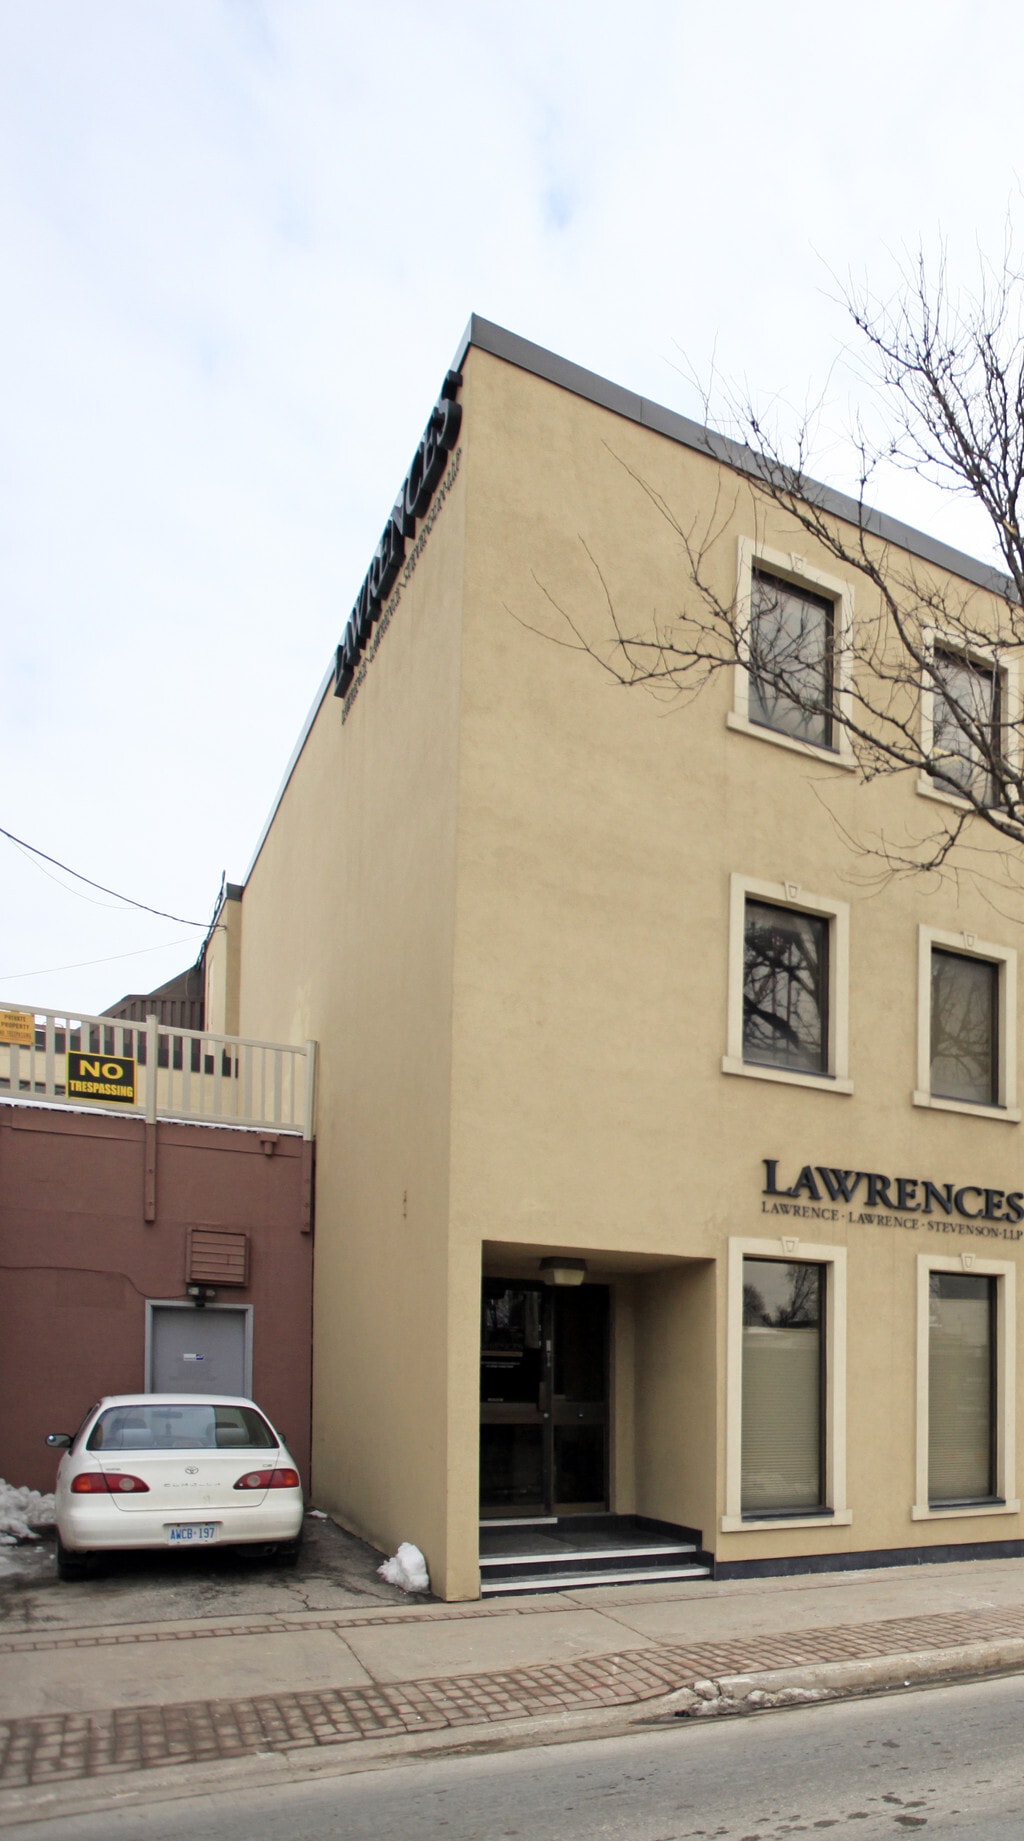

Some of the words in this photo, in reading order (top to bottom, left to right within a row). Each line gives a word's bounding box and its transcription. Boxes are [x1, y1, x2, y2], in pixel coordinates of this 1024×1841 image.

[79, 1060, 123, 1079] NO
[69, 1080, 133, 1097] TRESPASSING
[761, 1158, 1024, 1223] LAWRENCES
[761, 1201, 839, 1221] LAWRENCE
[848, 1211, 920, 1230] LAWRENCE
[170, 1527, 193, 1540] AWCB
[199, 1527, 215, 1539] 197
